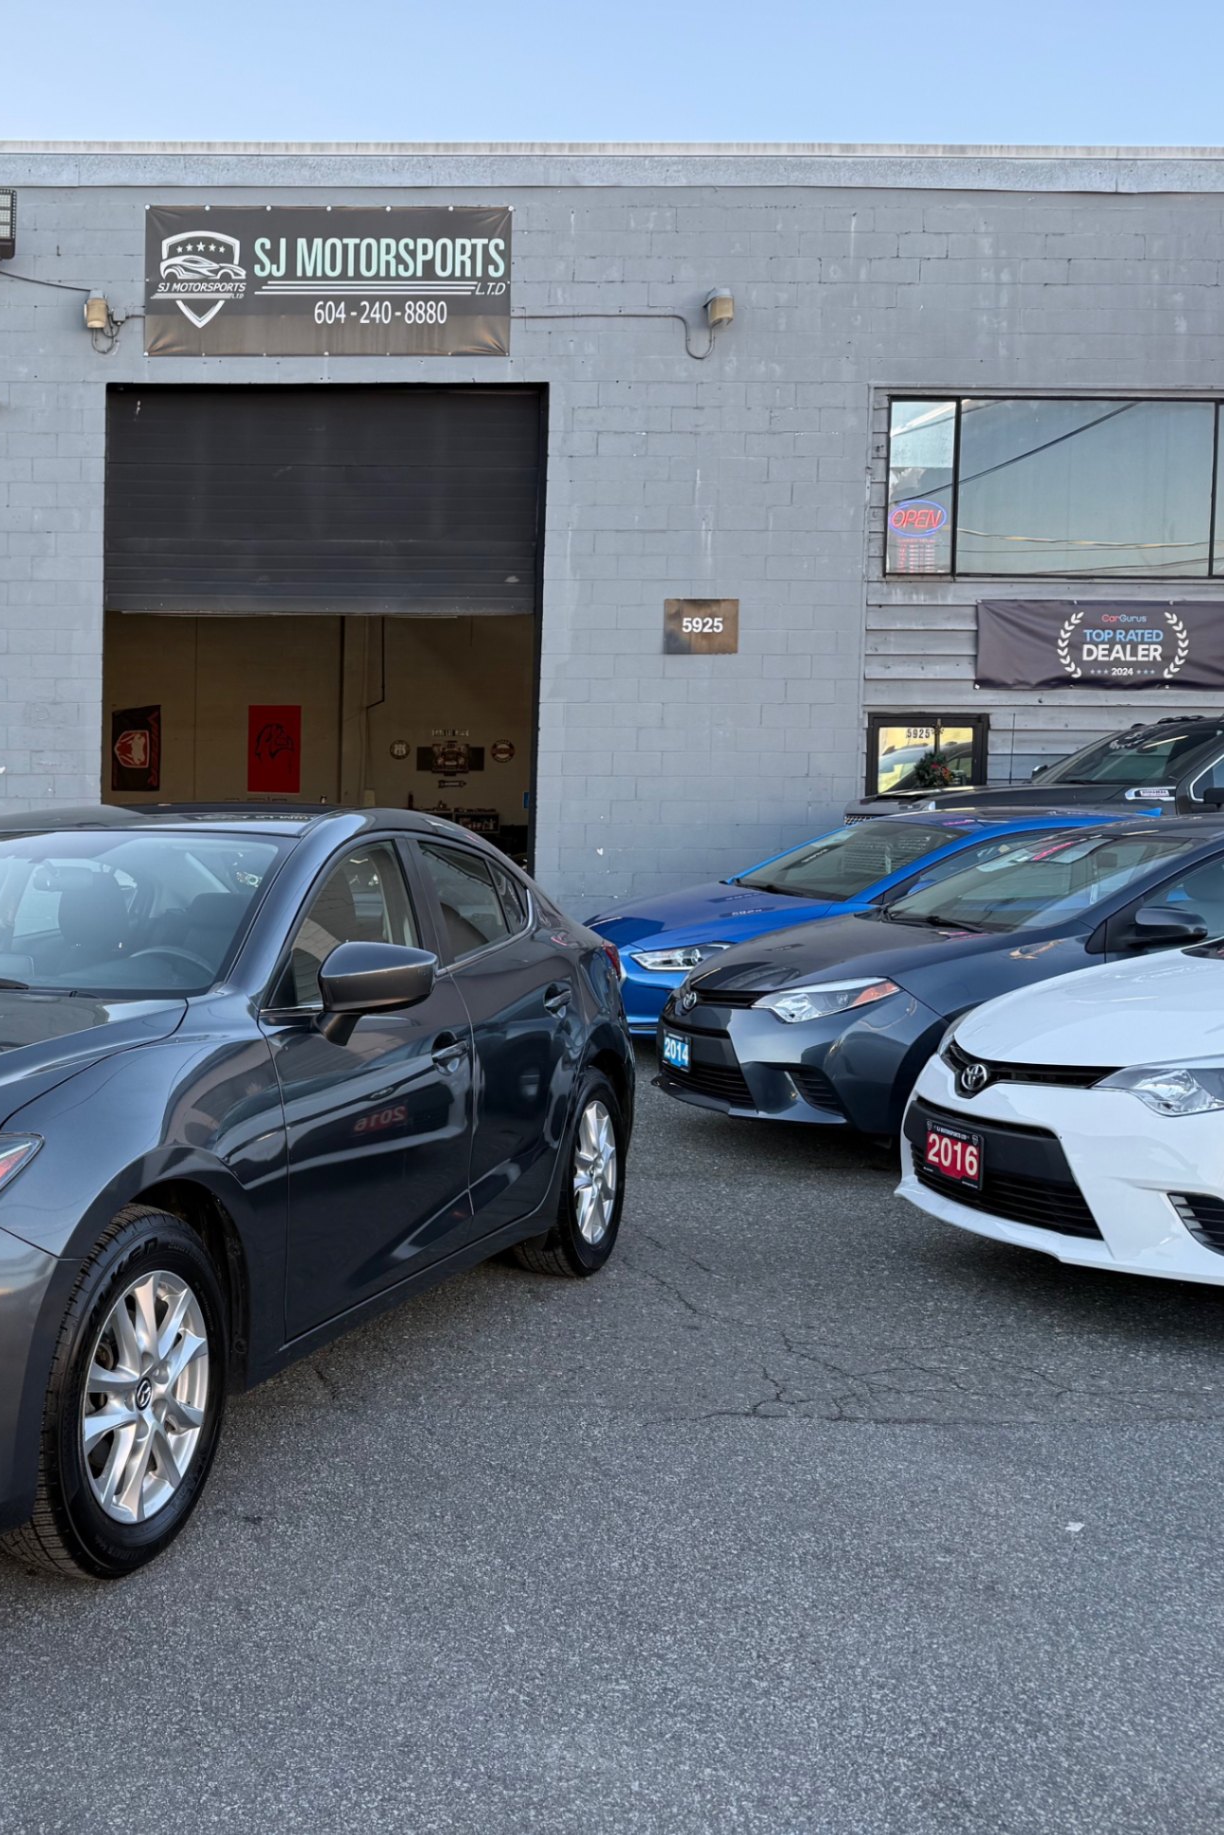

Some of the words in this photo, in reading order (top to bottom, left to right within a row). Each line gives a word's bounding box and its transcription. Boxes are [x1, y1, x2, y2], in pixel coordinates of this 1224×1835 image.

[254, 237, 287, 277] SJ
[296, 237, 505, 278] MOTORSPORTS
[157, 282, 170, 292] SJ
[171, 282, 247, 292] MOTORSPORTS
[891, 509, 942, 528] OPEN
[681, 617, 724, 633] 5925
[1101, 614, 1147, 623] CarGurus
[1083, 629, 1114, 642] TOP
[1118, 629, 1164, 642] RATED
[1082, 644, 1163, 661] DEALER
[1111, 667, 1134, 675] 2024
[906, 728, 931, 739] 5925
[664, 1036, 689, 1067] 2014
[927, 1133, 978, 1176] 2016
